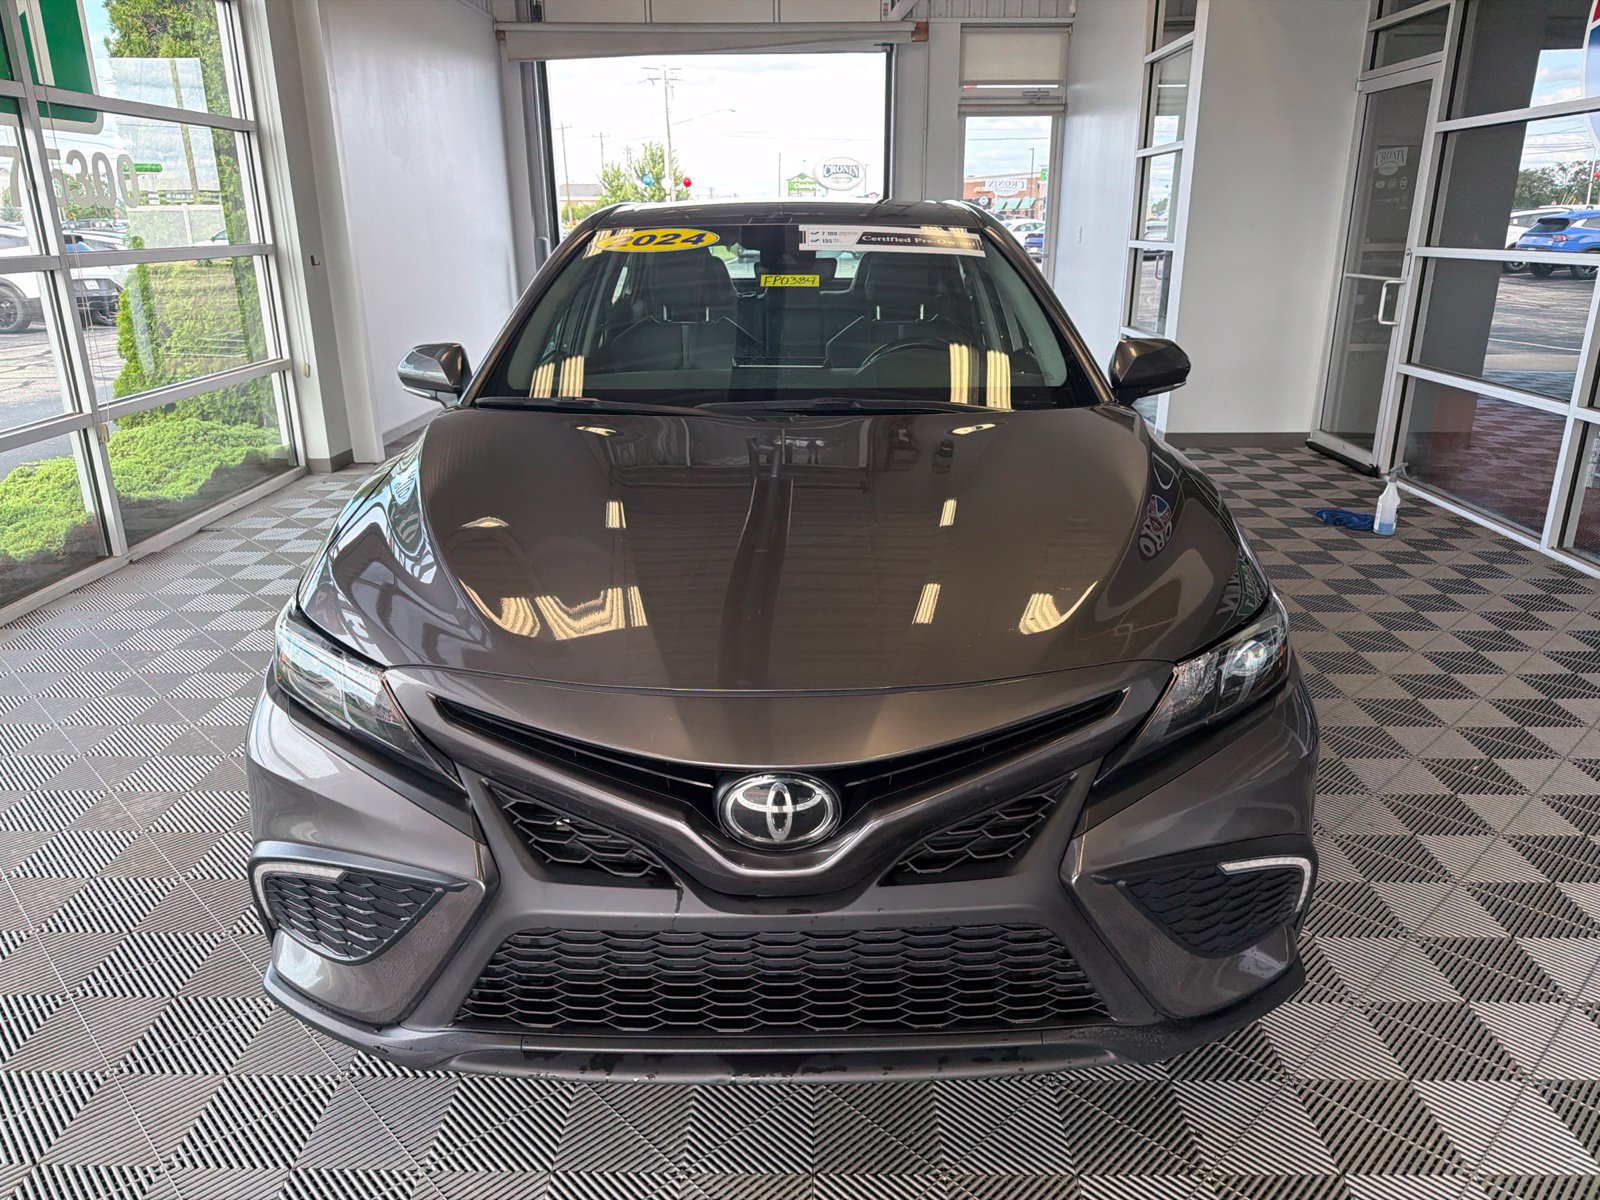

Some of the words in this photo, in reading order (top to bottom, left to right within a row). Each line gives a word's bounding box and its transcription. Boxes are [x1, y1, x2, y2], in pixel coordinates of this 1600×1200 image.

[1376, 149, 1405, 166] CRONIN
[823, 164, 860, 178] CRONIN
[604, 232, 707, 247] 2024
[861, 235, 911, 243] Certified
